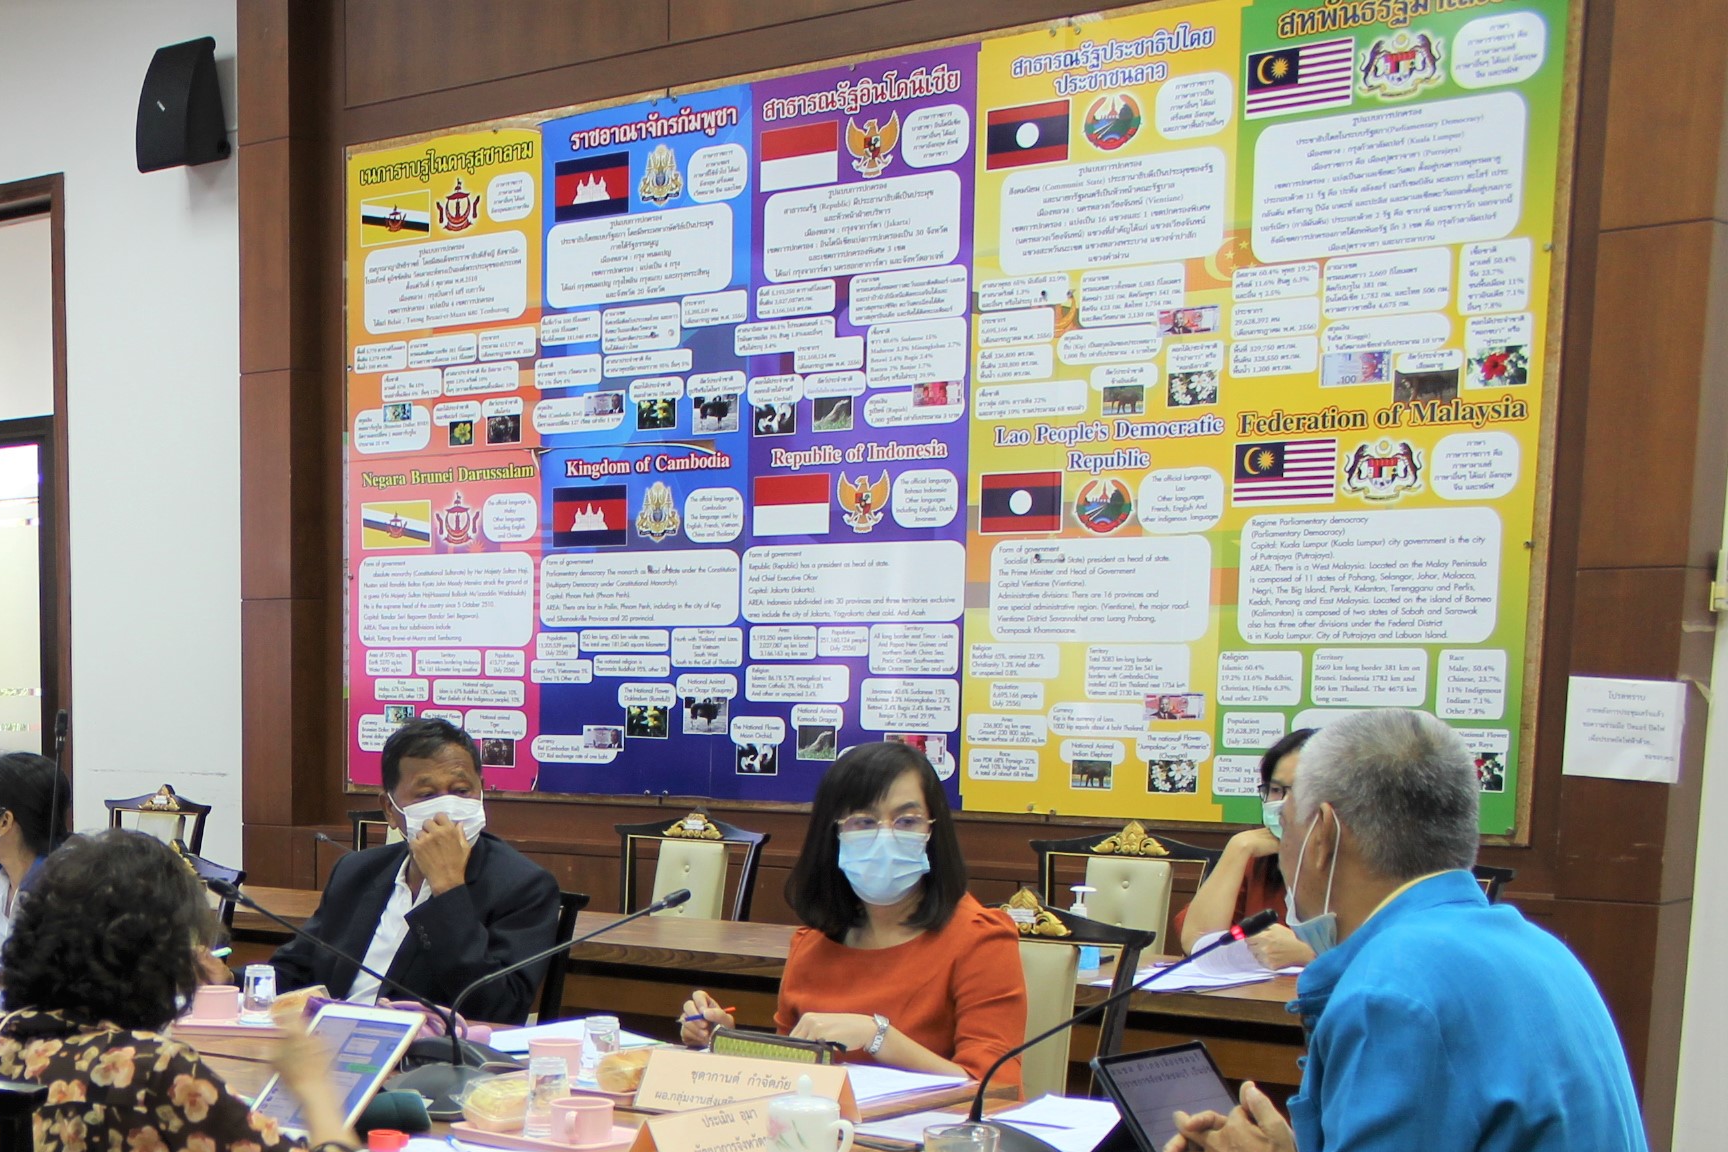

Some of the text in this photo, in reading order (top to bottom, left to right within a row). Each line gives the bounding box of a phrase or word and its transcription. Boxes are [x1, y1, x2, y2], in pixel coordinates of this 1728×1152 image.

[1012, 23, 1214, 78] สาธารณรัฐประชาธิปไตย
[763, 64, 961, 121] สาธารณรัฐอินโดนีเซีย
[1055, 61, 1166, 94] ประชาชนลาว
[570, 106, 739, 151] ราชอาณาจักรกัมพูชา
[994, 414, 1224, 448] Lao People's Democratic
[1237, 395, 1528, 436] Federation of Malaysia
[565, 453, 731, 480] Kingdom of Cambodia
[771, 439, 948, 470] Republic of Indonesia
[1066, 448, 1151, 474] Republic
[361, 464, 535, 489] Negara Brunei Darussalam
